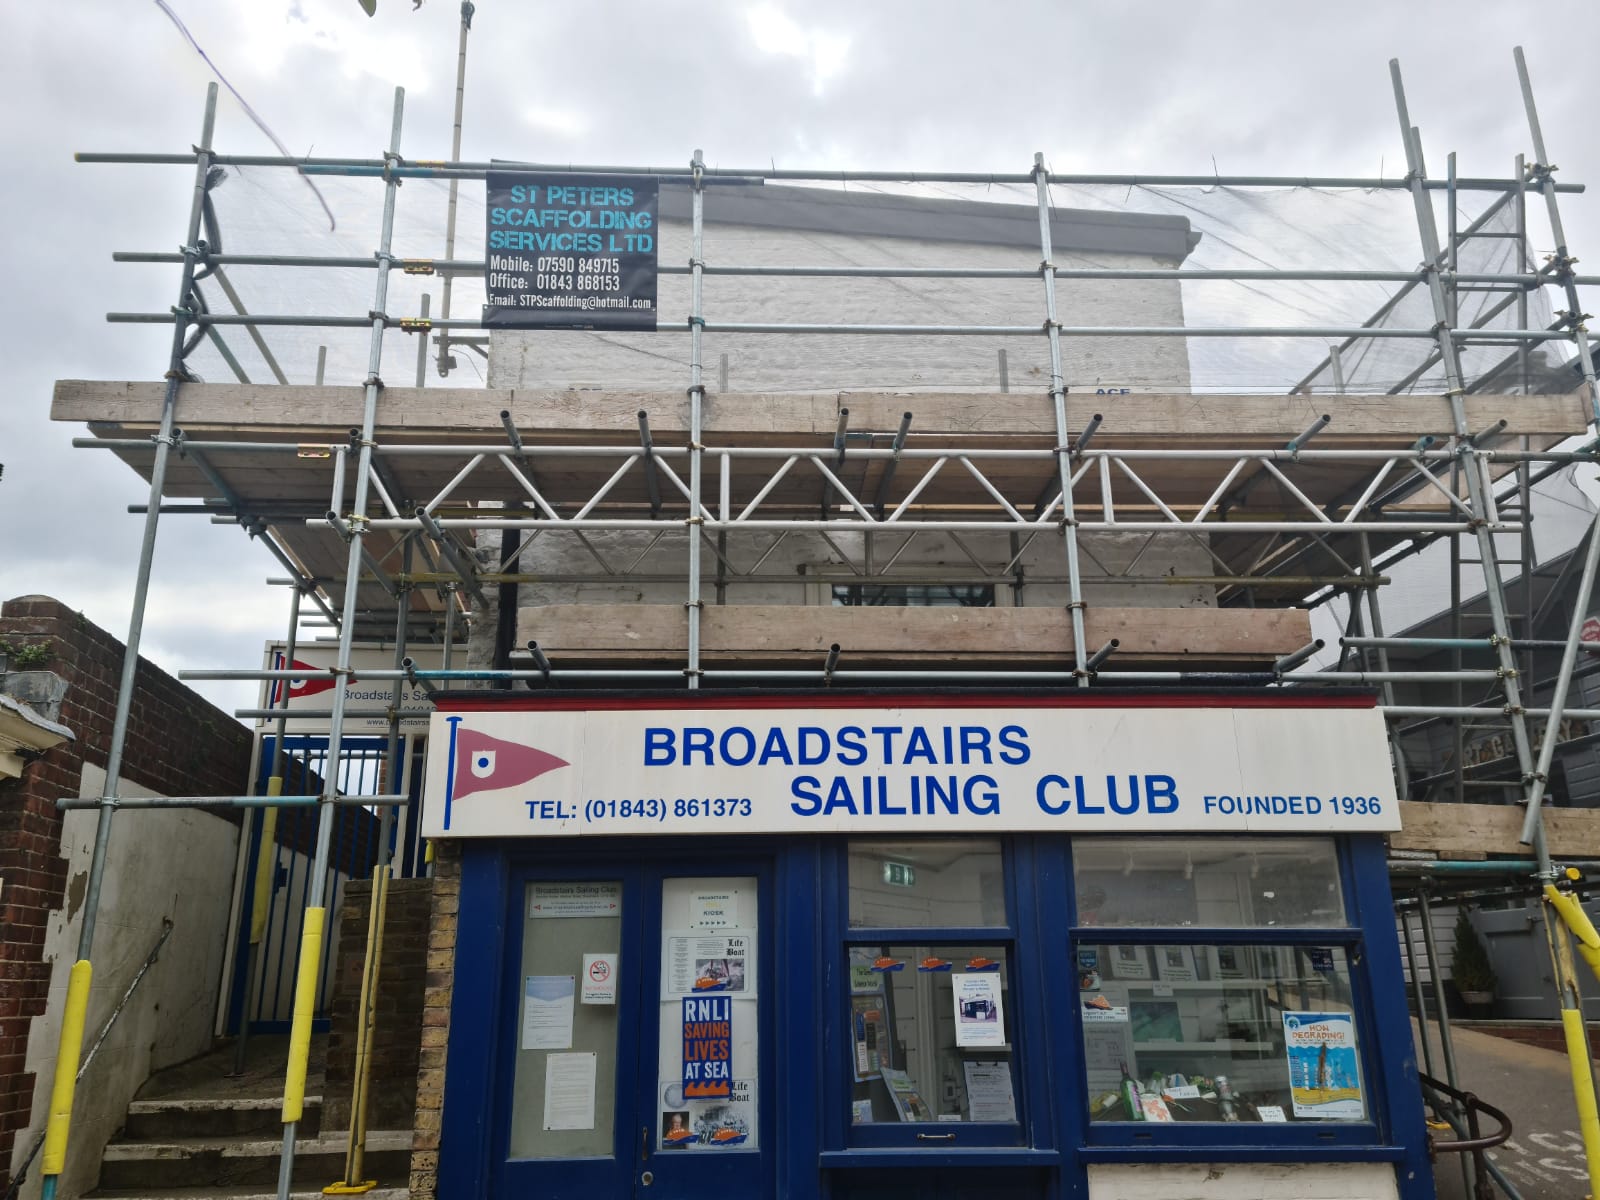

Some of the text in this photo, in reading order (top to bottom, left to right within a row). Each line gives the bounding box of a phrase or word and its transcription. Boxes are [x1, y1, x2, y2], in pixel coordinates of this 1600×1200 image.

[510, 184, 634, 206] ST PETERS
[490, 208, 653, 230] SCAFFOLDING
[489, 230, 653, 253] SERVICES LTD
[490, 255, 620, 274] Mobile: 07590 849715
[489, 273, 620, 292] Office: 01843 868153
[489, 294, 651, 310] Email: STPScaffolding@hotmail.com
[345, 689, 408, 700] Broadstas
[643, 725, 1031, 767] BROADSTAIRS
[790, 774, 1180, 817] SAILING CLUB
[1203, 796, 1382, 815] FOUNDED 1936
[526, 798, 752, 822] TEL: (01843) 861373
[685, 999, 729, 1022] RNLI
[684, 1021, 729, 1039] SAVING
[684, 1039, 729, 1061] LIVES
[685, 1061, 729, 1080] AT SEA
